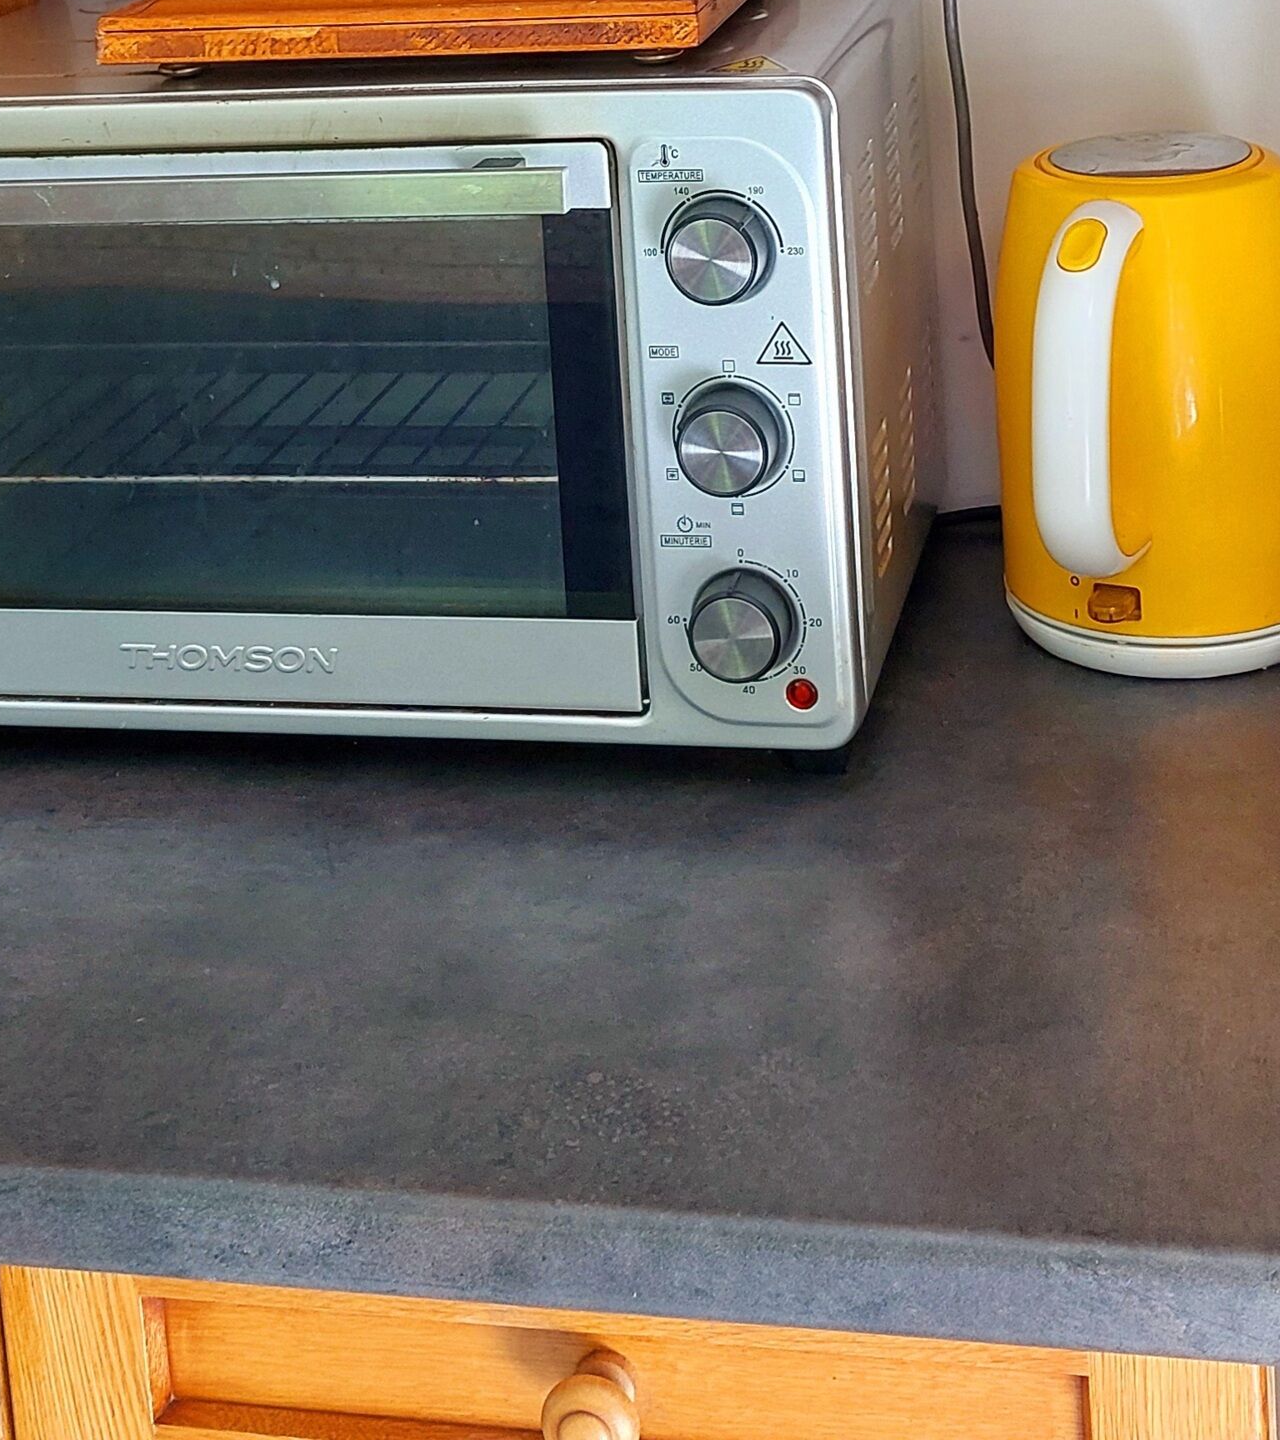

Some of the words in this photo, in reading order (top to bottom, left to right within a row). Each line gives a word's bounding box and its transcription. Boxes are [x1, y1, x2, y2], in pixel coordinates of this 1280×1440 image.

[641, 171, 701, 181] TEMPERATURE
[673, 186, 689, 195] 140
[748, 186, 764, 195] 190
[643, 247, 658, 256] 100
[787, 247, 804, 256] 230
[652, 348, 676, 357] MODE
[695, 521, 711, 529] MIN
[664, 537, 708, 546] MINUTERIE
[738, 548, 744, 557] 0
[786, 569, 799, 578] 10
[667, 616, 680, 624] 60
[809, 619, 822, 627] 20
[120, 642, 337, 673] THOMSON
[690, 663, 702, 672] 50
[793, 666, 806, 674] 30
[743, 686, 755, 695] 40
